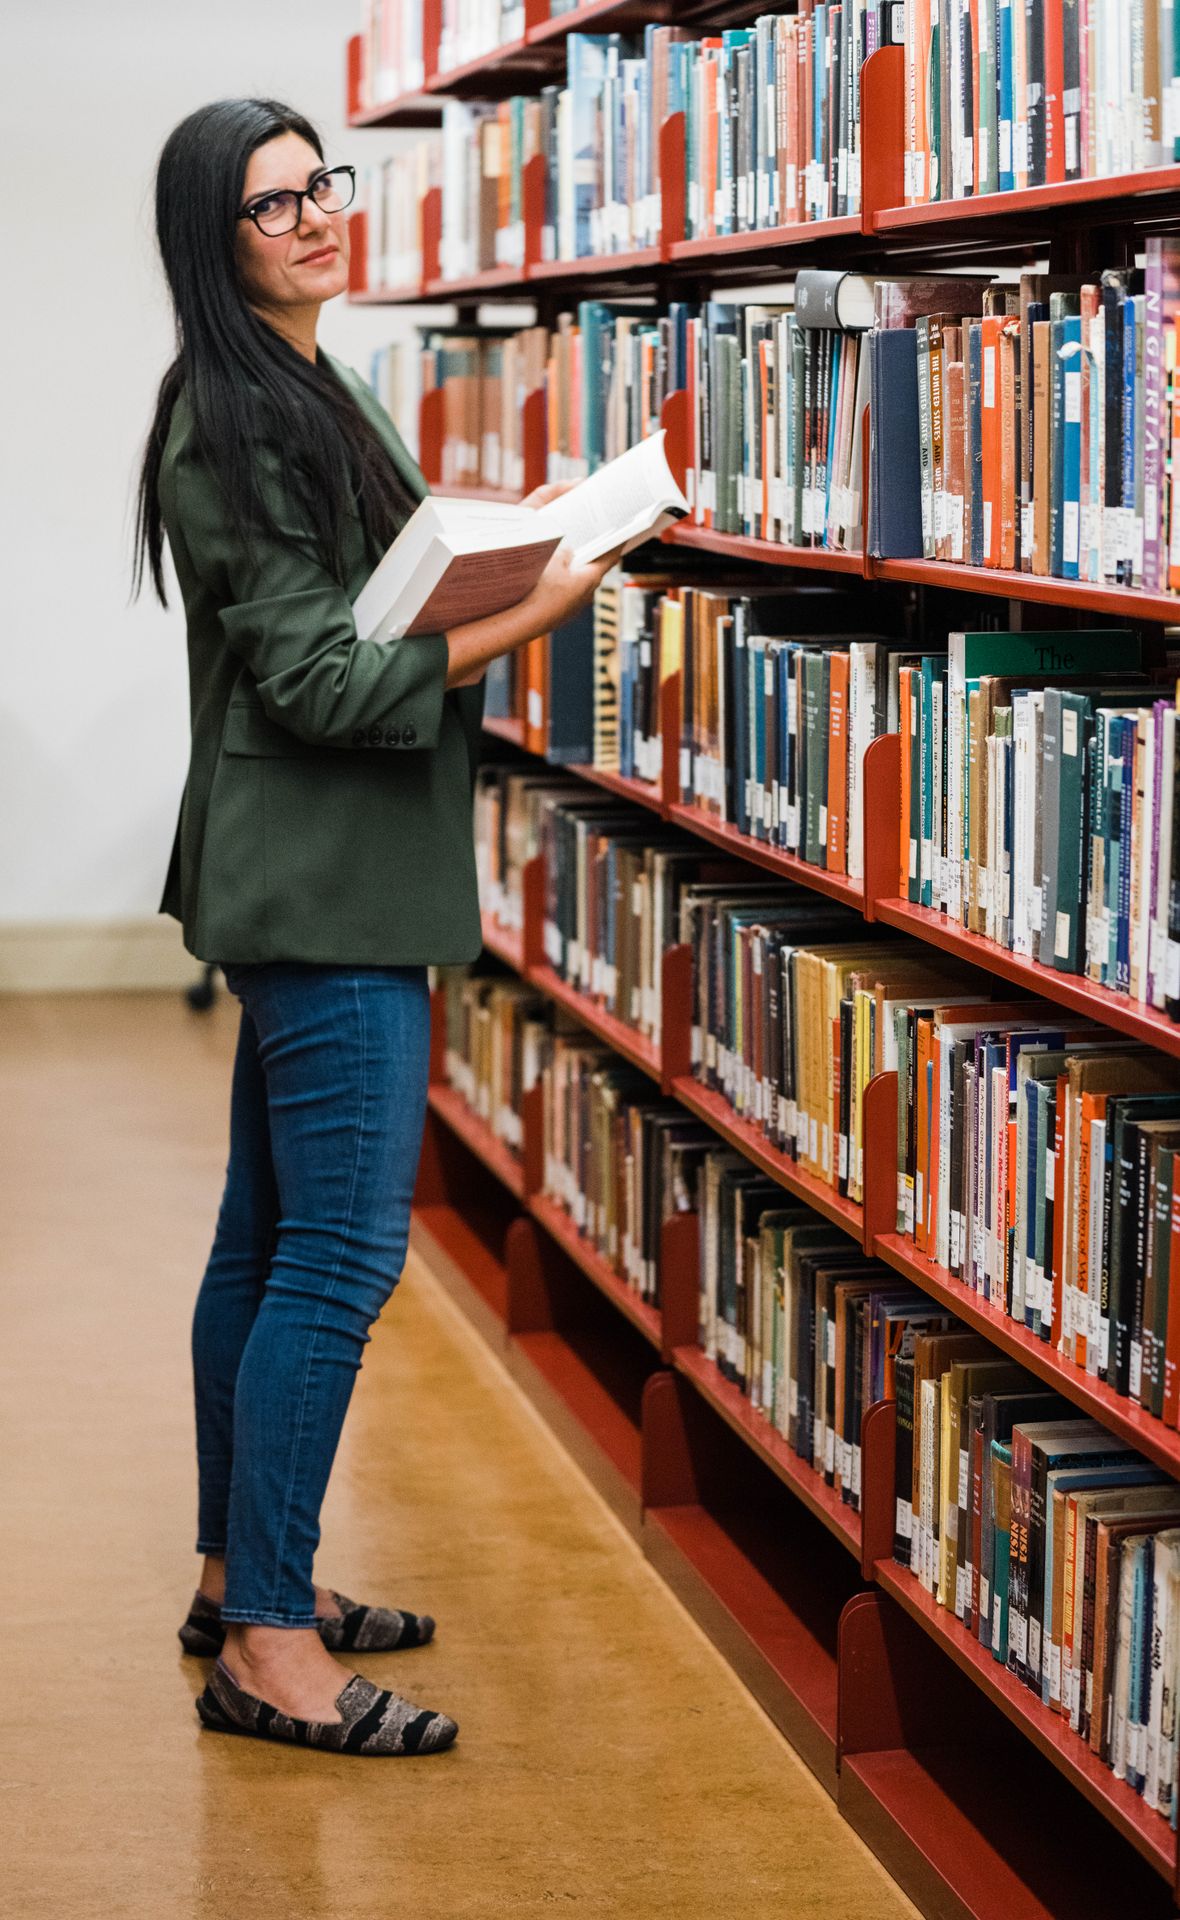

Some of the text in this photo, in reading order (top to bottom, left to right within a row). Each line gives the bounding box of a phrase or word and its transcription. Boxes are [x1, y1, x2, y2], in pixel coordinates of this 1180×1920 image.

[919, 358, 927, 376] THE
[932, 354, 940, 373] THE
[933, 374, 941, 407] UNITED
[1034, 646, 1075, 670] The
[1095, 715, 1104, 831] PARALLEL WORLDS
[1067, 1507, 1075, 1535] SOUTH
[1009, 1518, 1019, 1559] NISA
[1019, 1524, 1029, 1564] NISA
[1066, 1533, 1075, 1561] AFRICA
[1065, 1561, 1074, 1596] WITHOUT
[1064, 1594, 1073, 1636] APARTHEID
